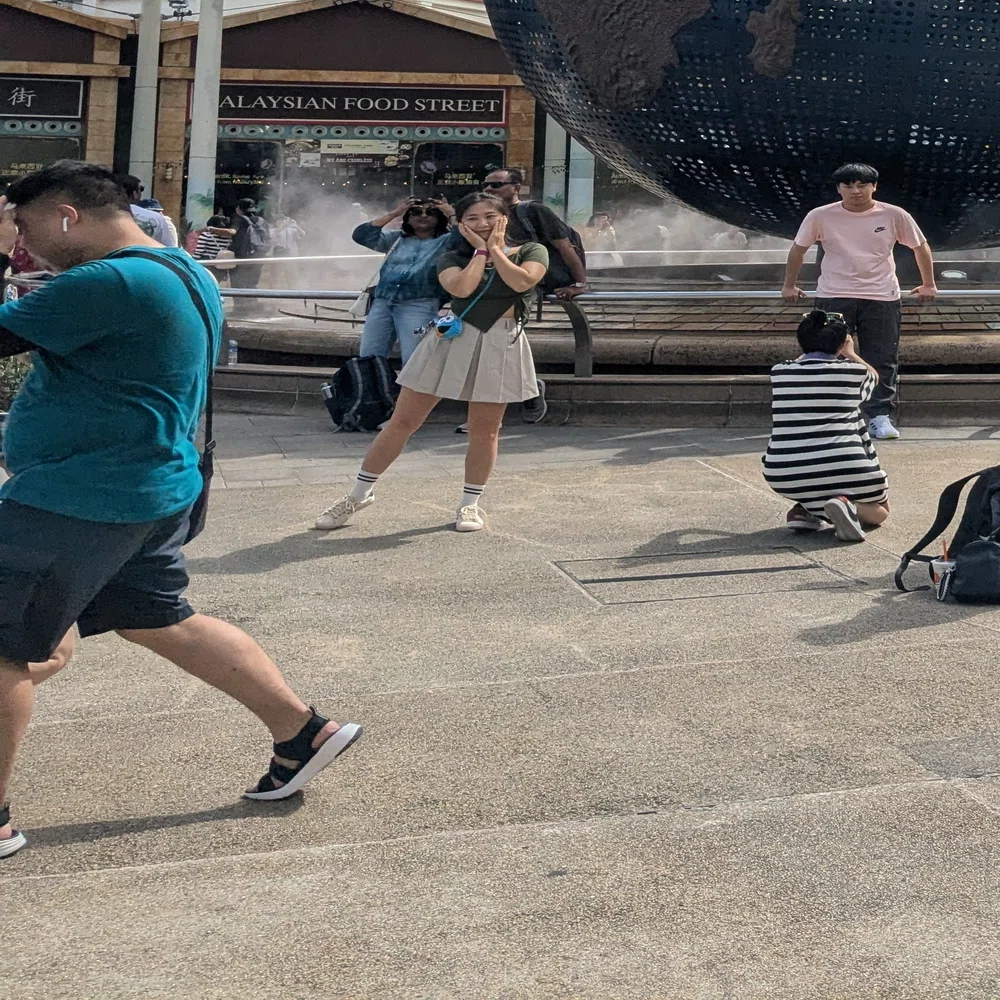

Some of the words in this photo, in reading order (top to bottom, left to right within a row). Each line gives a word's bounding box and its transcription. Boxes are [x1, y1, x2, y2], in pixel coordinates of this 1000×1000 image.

[8, 86, 37, 108] 街
[219, 95, 337, 111] ALAYSIAN
[343, 97, 409, 112] FOOD
[414, 98, 500, 113] STREET
